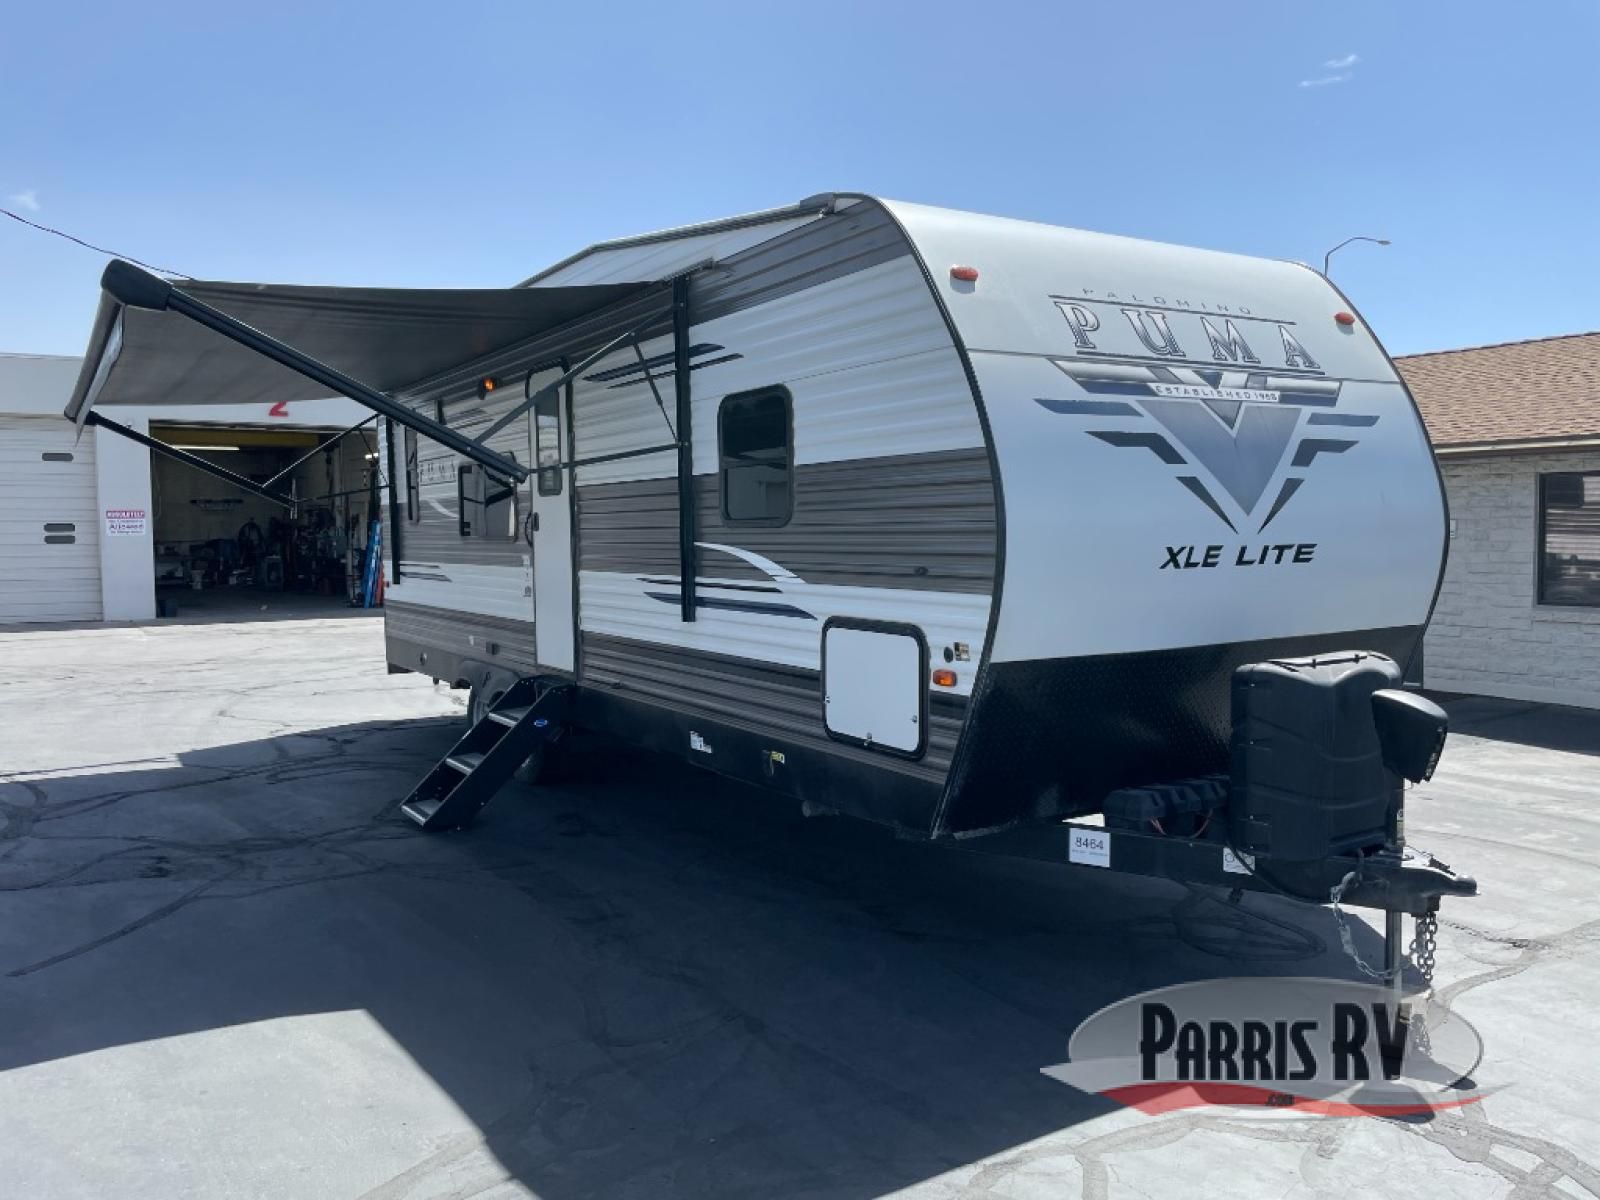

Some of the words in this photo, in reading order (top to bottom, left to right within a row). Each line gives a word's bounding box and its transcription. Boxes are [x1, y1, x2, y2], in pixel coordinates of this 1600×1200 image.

[1082, 288, 1251, 314] PALOMINO
[1054, 301, 1320, 369] PUMA
[1155, 385, 1251, 399] ESTABLISHED
[1159, 545, 1224, 569] XLE
[1236, 543, 1318, 566] LITE
[1075, 836, 1104, 850] 8464
